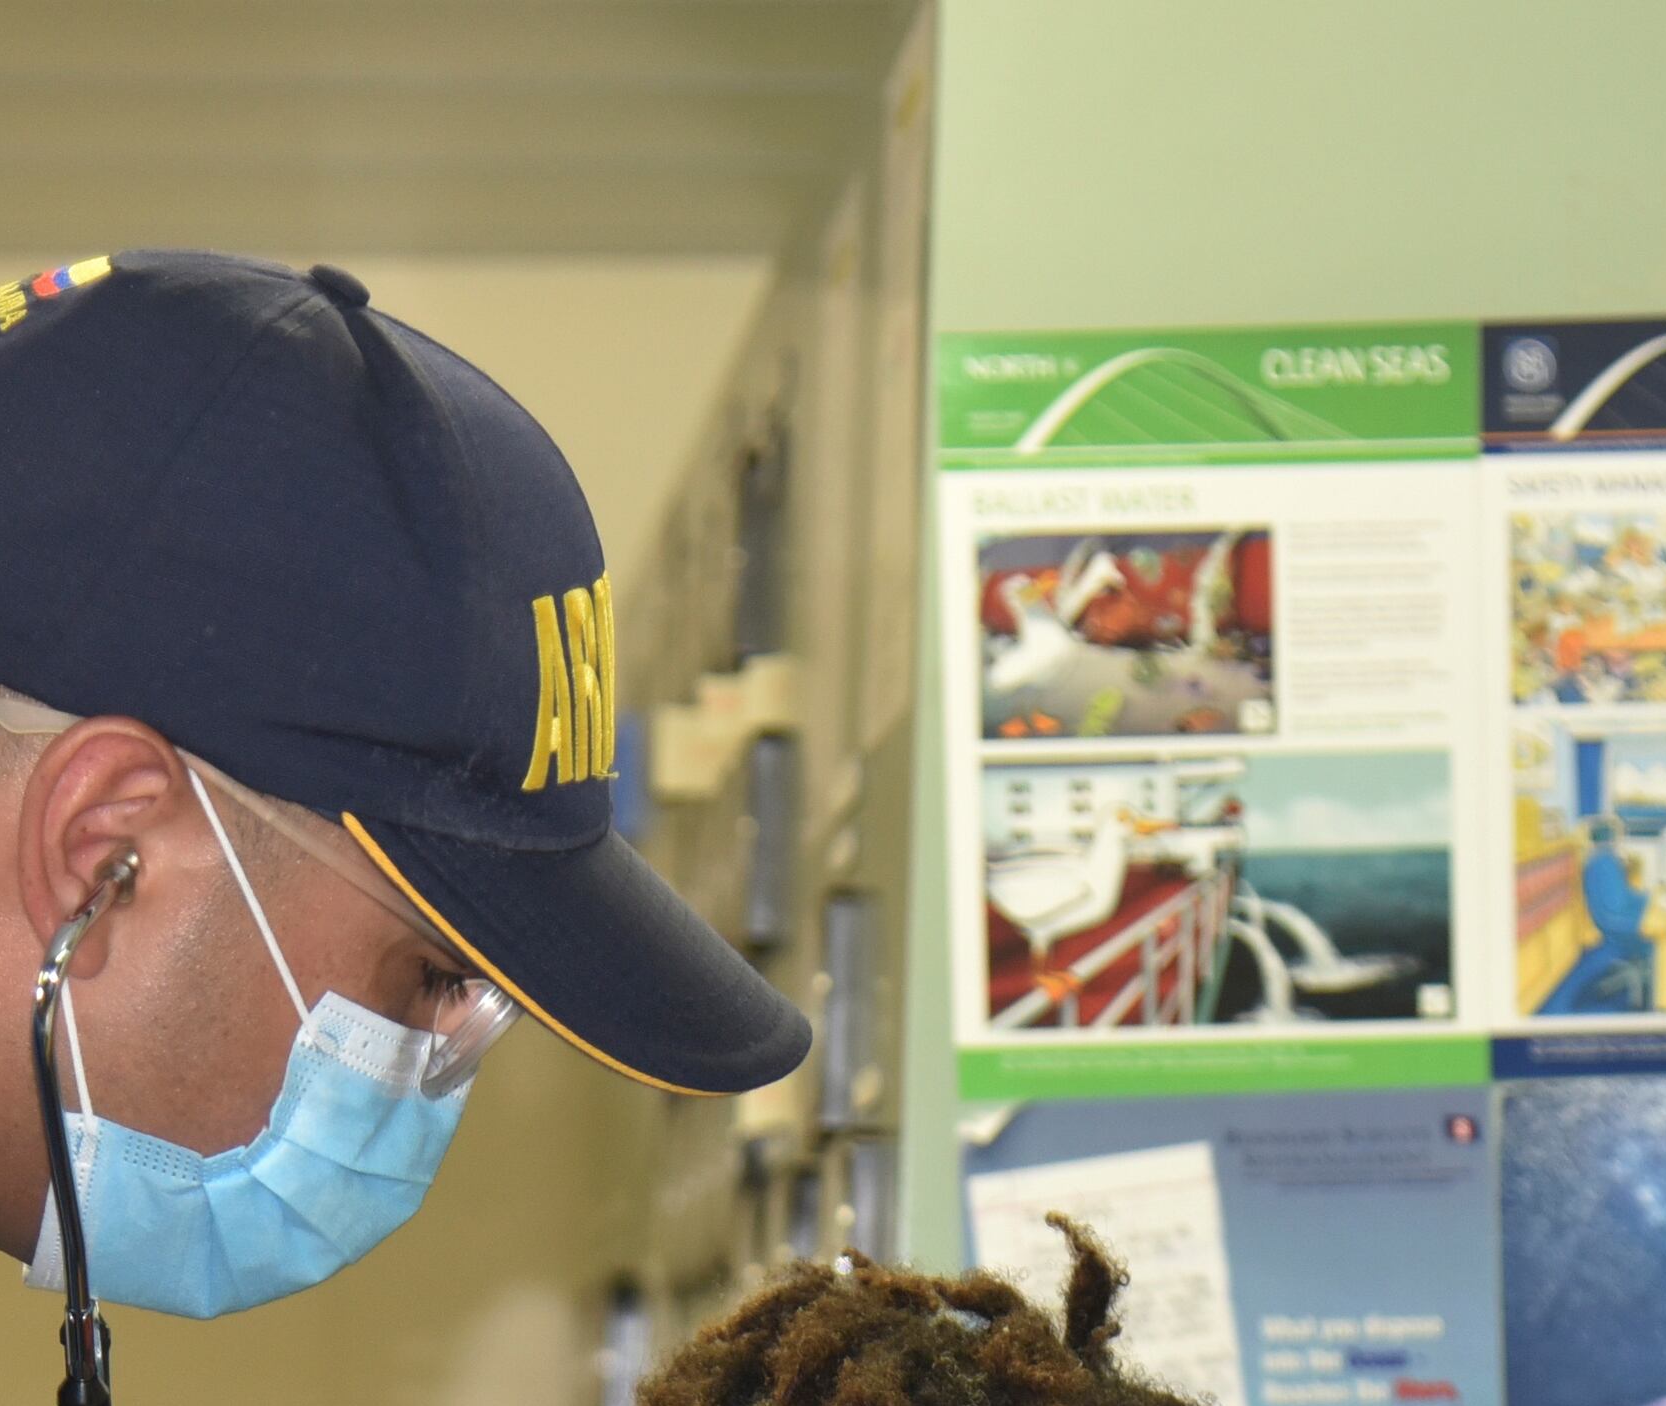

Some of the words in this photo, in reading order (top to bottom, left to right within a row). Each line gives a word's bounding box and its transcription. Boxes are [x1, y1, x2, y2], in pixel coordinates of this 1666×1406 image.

[963, 353, 1057, 381] NORTH
[1261, 347, 1363, 388] CLEAN
[1367, 344, 1451, 384] SEAS
